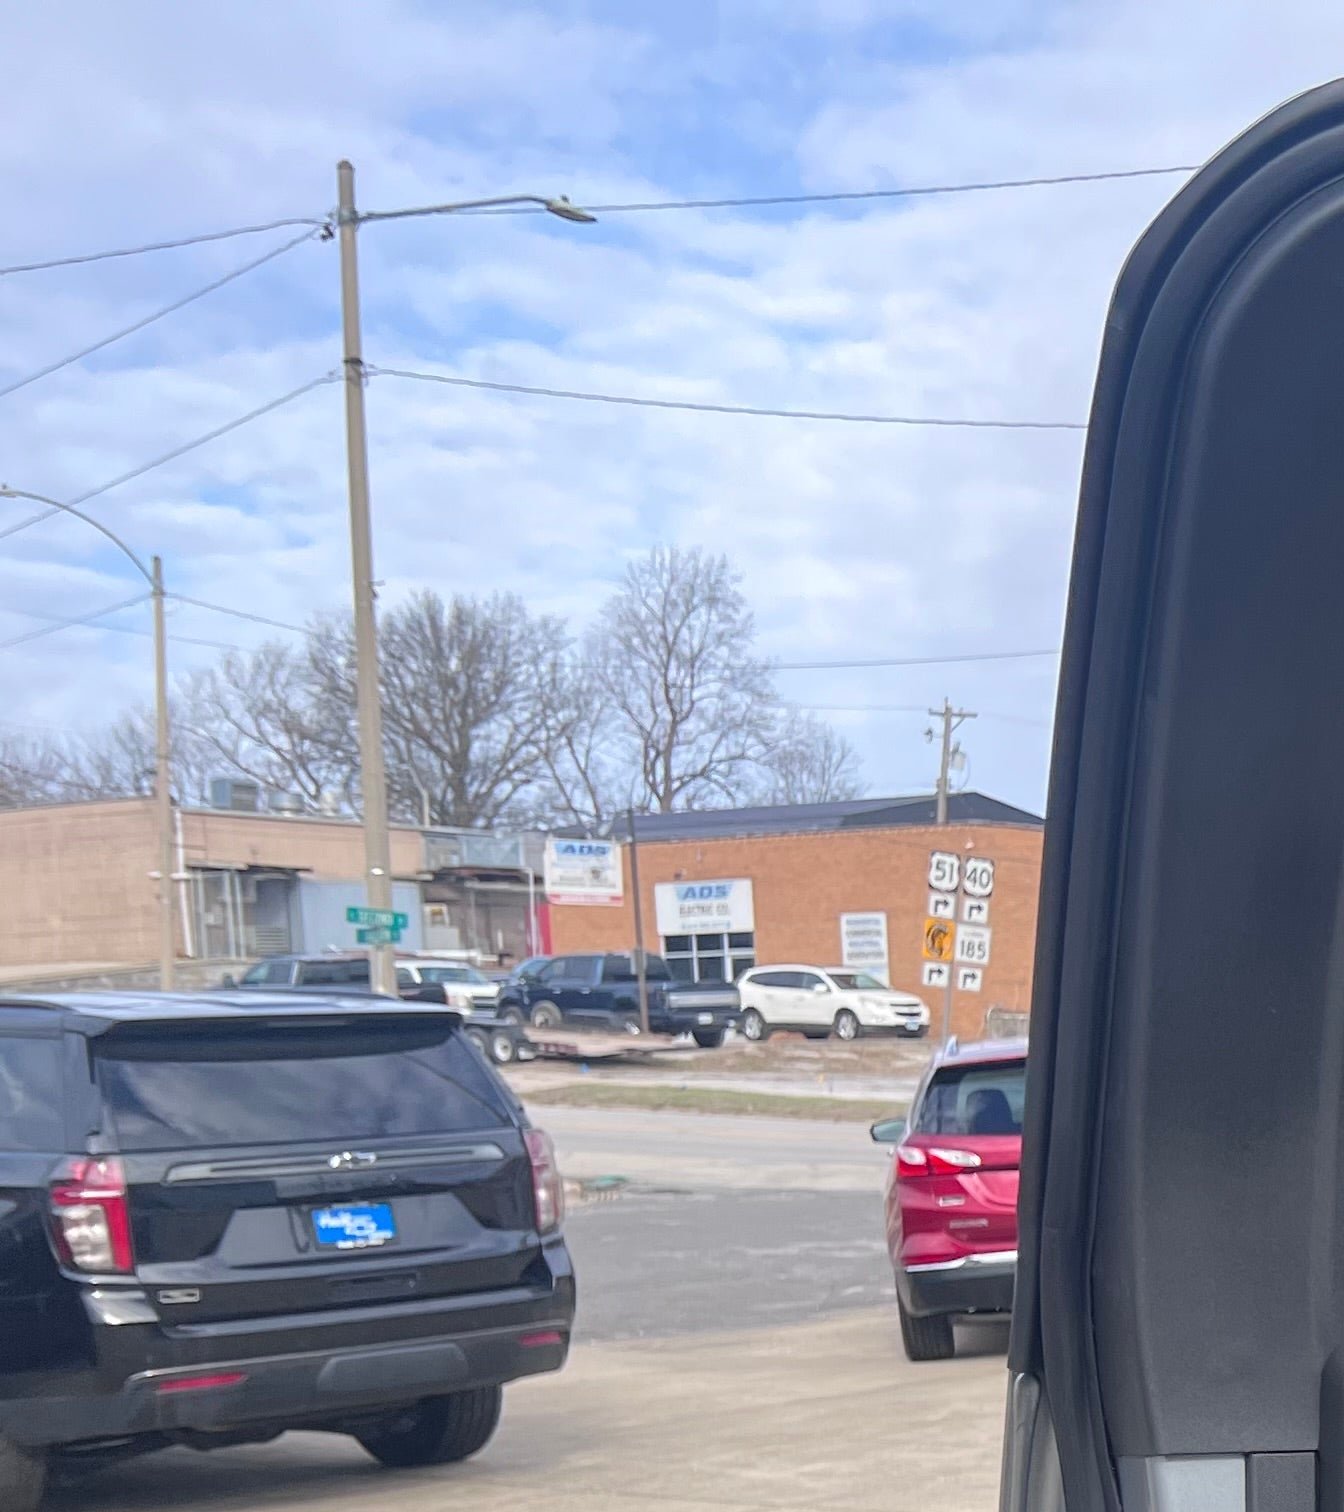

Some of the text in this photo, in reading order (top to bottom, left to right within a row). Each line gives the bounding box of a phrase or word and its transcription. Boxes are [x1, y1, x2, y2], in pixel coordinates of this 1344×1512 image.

[934, 859, 955, 883] 51
[966, 866, 991, 889] 40
[682, 885, 727, 900] ADS
[959, 938, 987, 960] 185
